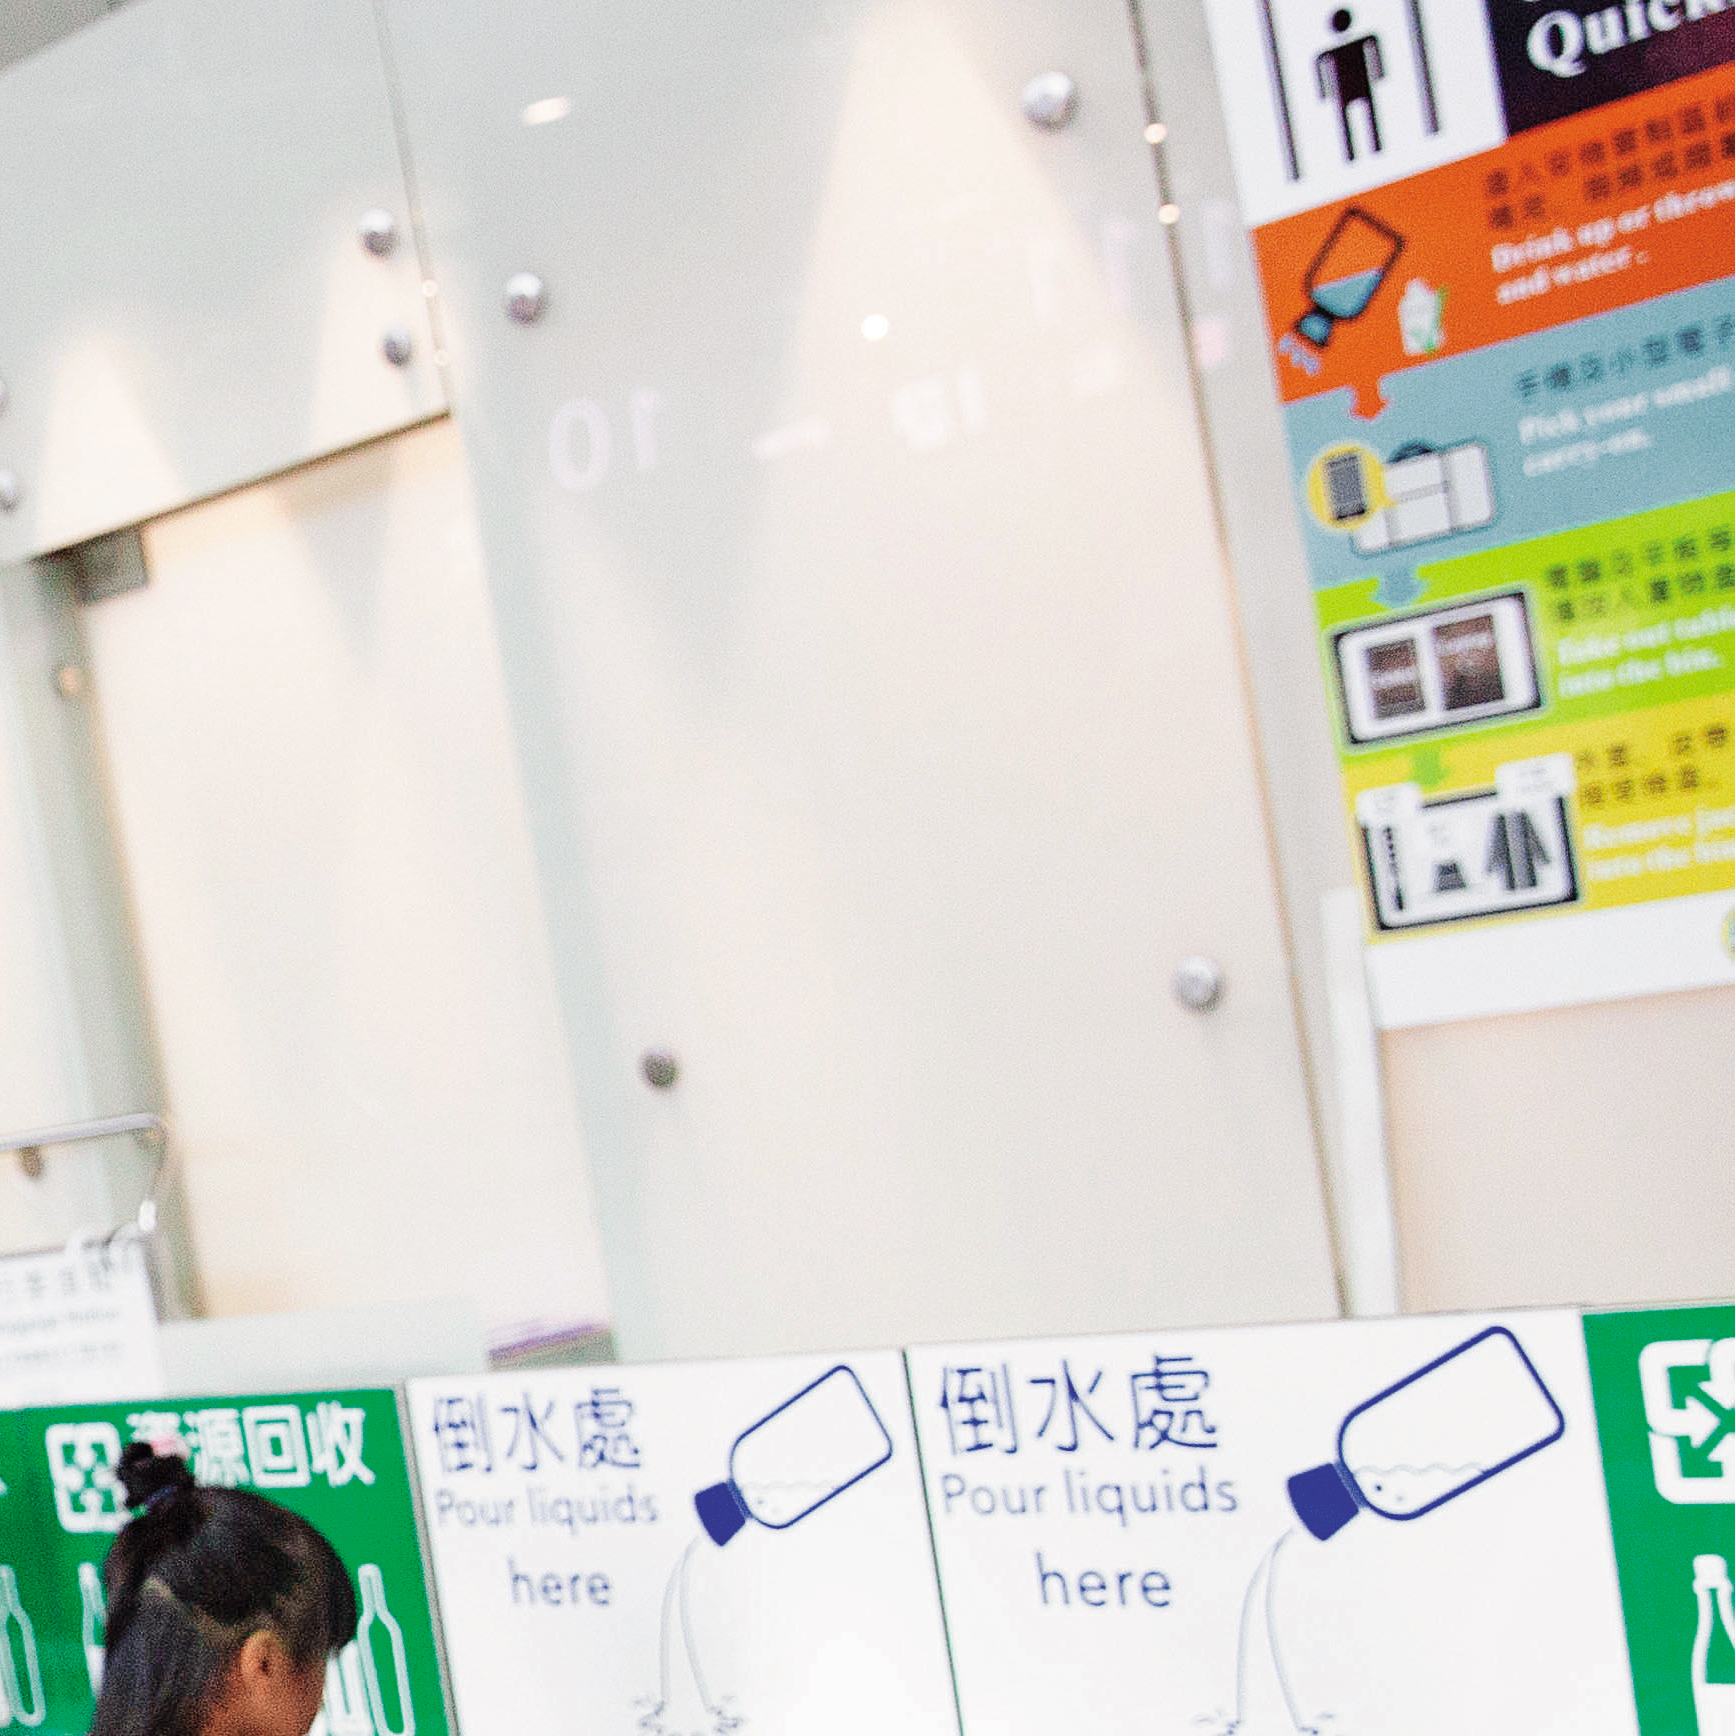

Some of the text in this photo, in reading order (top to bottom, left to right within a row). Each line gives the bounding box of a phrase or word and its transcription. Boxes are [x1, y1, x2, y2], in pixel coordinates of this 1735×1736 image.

[431, 1386, 643, 1475] 倒水處
[939, 1351, 1219, 1457] 倒水處
[434, 1483, 659, 1535] Pour liquids
[941, 1465, 1240, 1528] Pour liquids
[506, 1556, 613, 1608] here
[1035, 1550, 1172, 1608] here
